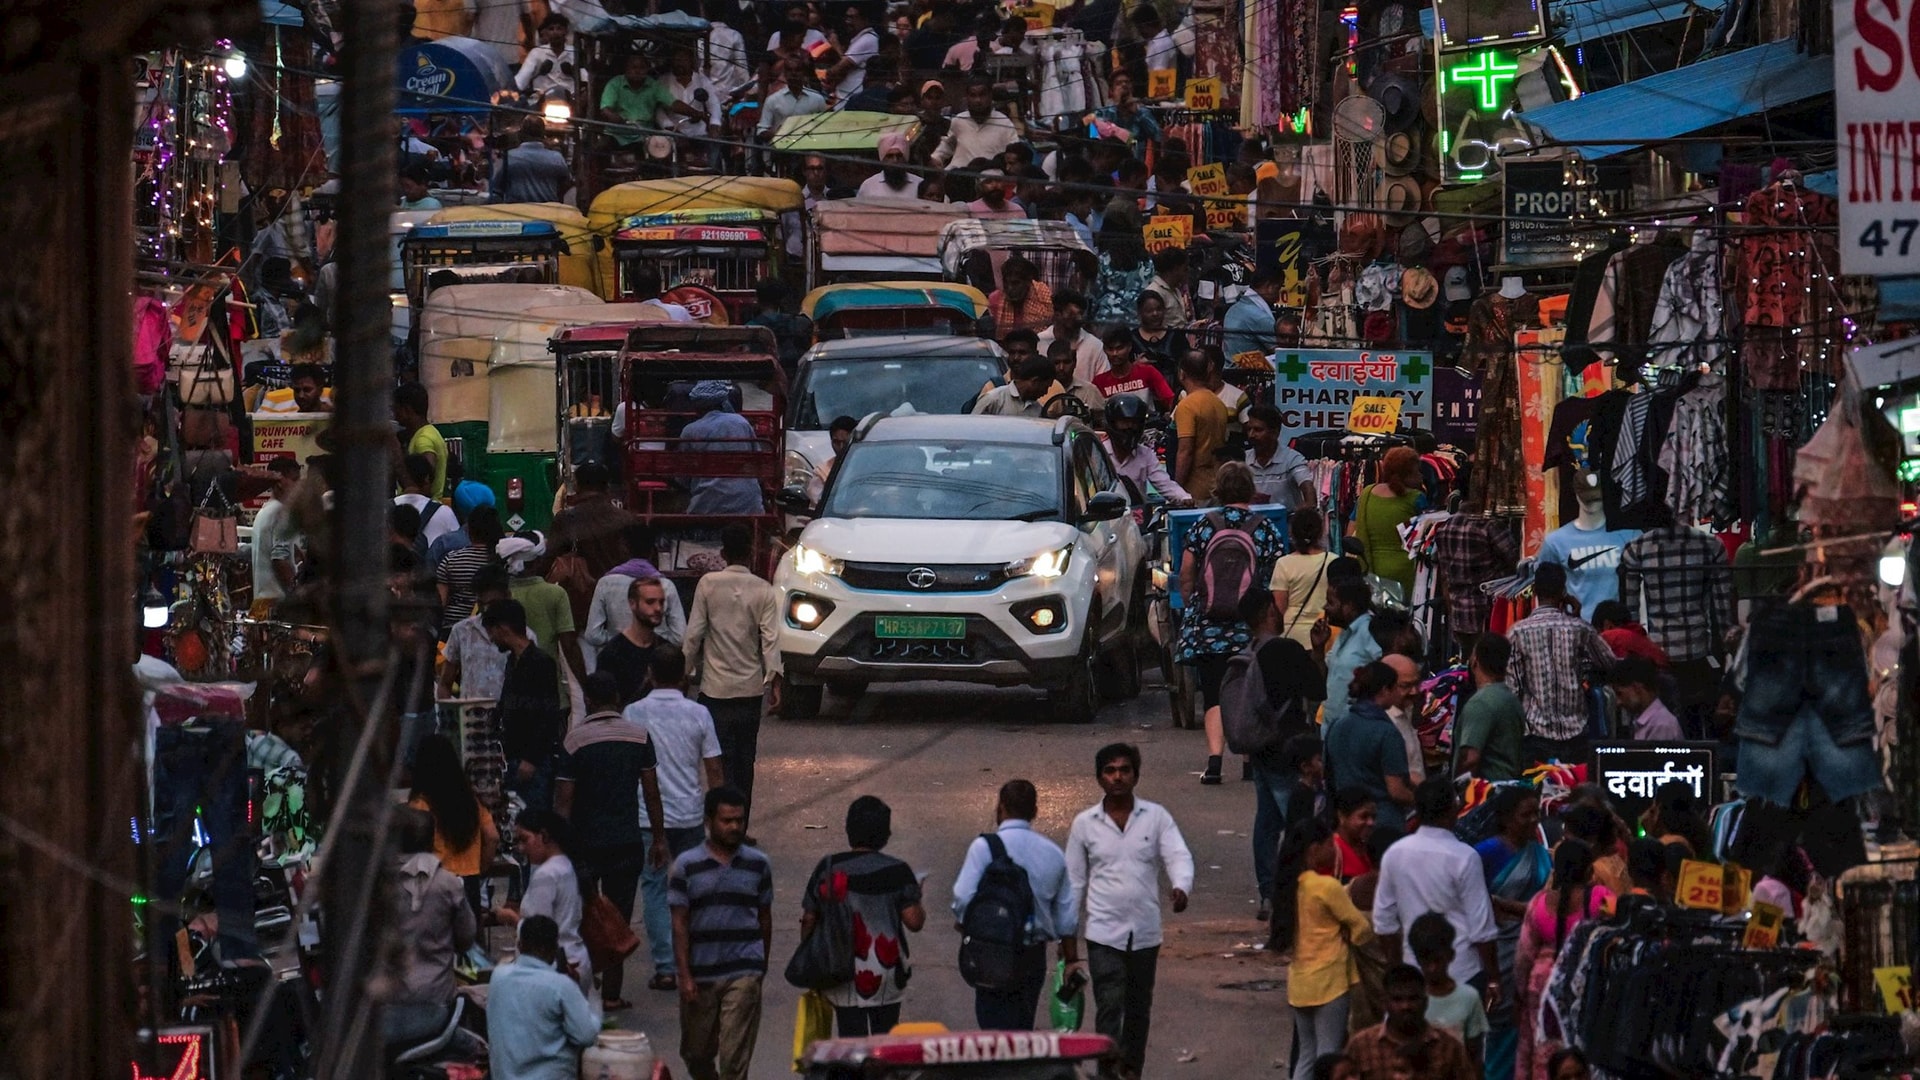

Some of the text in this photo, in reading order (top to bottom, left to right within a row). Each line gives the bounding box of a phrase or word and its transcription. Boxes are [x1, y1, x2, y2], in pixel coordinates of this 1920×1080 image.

[1854, 0, 1920, 93] S
[406, 73, 447, 90] Cream
[1192, 95, 1213, 109] 200
[1196, 169, 1215, 181] SALE
[1194, 180, 1226, 195] 150/-
[701, 230, 749, 241] 9211696901
[1153, 228, 1172, 239] SALE
[1310, 352, 1397, 386] दवाईयाँ
[1104, 379, 1144, 396] WARRIOR
[1363, 403, 1387, 414] SALE
[1352, 414, 1394, 429] 100/-
[254, 426, 312, 437] DRUNKYARD
[261, 439, 285, 449] CAFE
[1569, 544, 1621, 571] NIKE
[883, 619, 964, 635] HR55AP7137
[922, 1033, 1062, 1065] SHATABDI
